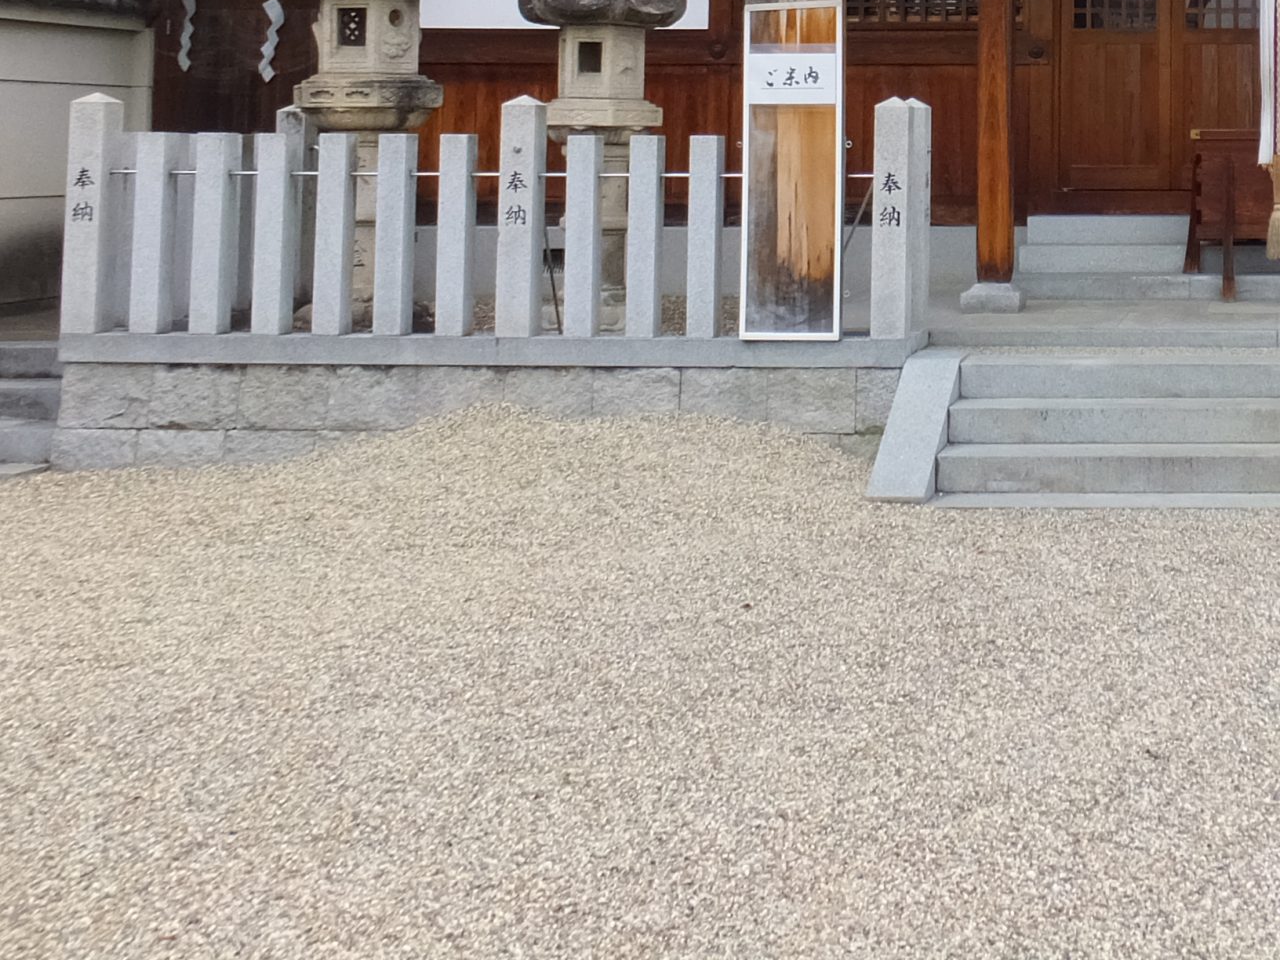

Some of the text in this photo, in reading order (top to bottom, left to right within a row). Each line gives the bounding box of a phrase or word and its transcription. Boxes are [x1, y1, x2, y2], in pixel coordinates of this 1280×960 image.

[765, 65, 820, 88] ご案内
[71, 166, 95, 224] 奉納
[504, 169, 528, 227] 奉納
[879, 171, 903, 228] 奉納
